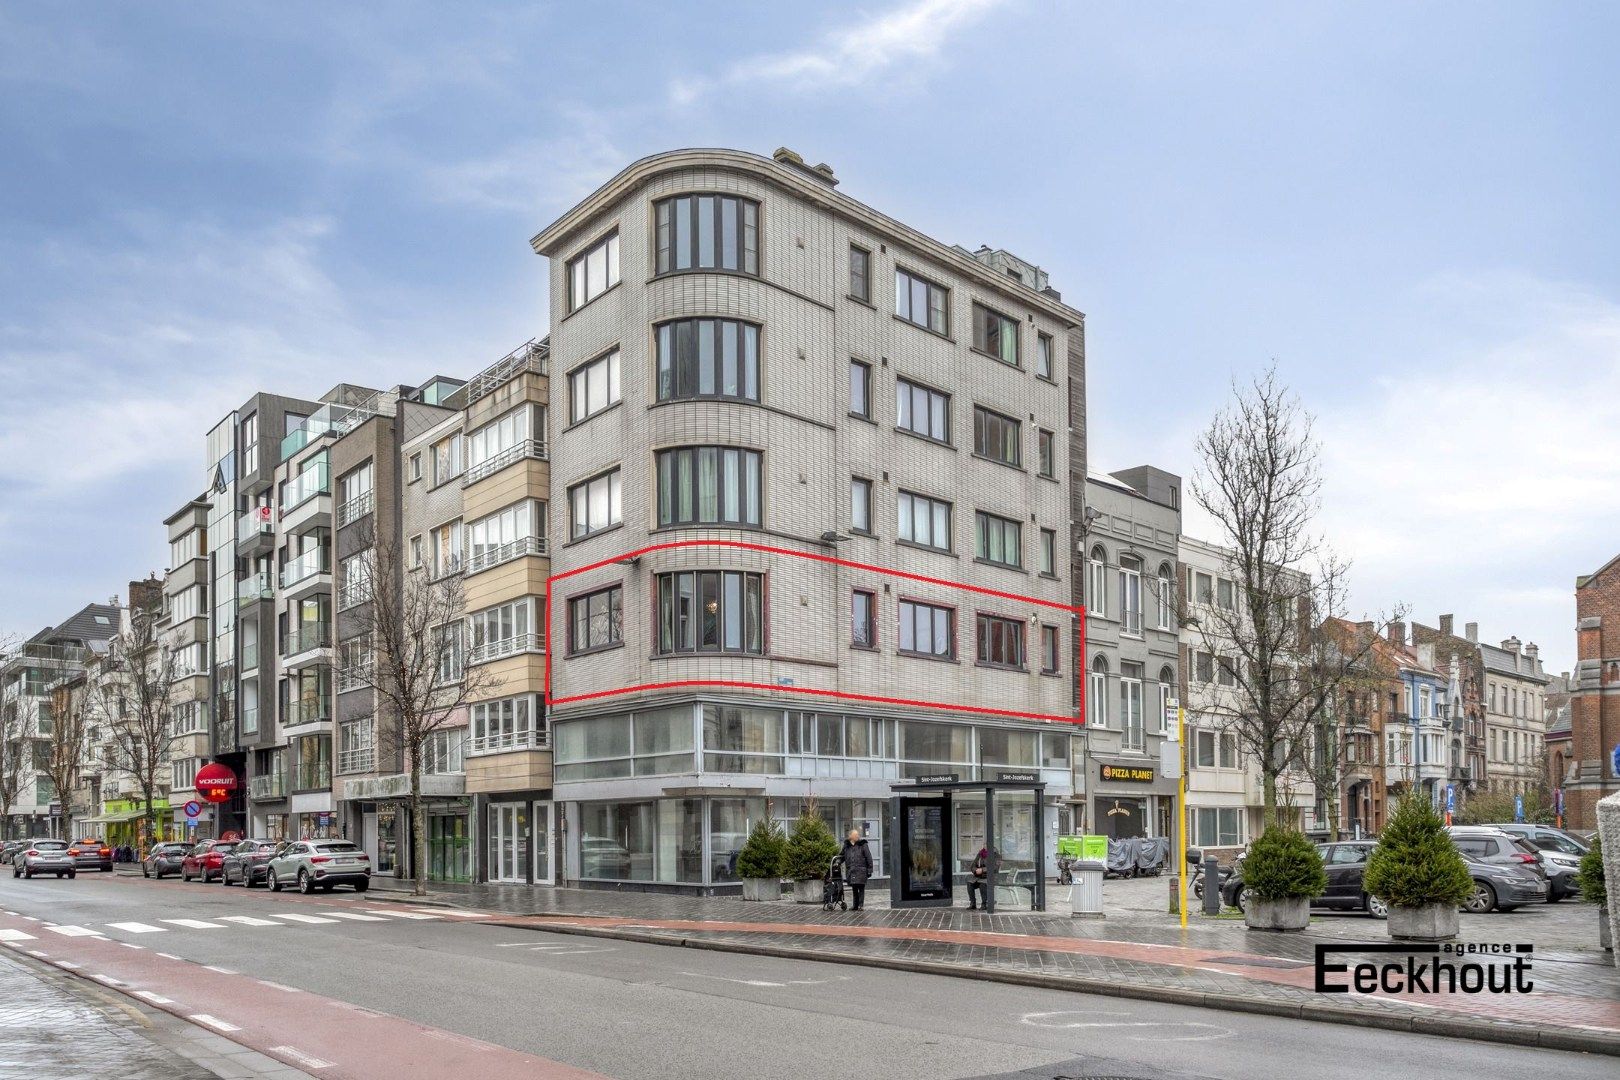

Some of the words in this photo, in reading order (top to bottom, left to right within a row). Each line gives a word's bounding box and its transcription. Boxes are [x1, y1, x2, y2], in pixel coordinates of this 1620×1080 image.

[1111, 768, 1130, 778] PIZZA
[1131, 769, 1153, 780] PLANET
[199, 777, 234, 785] VOORUIT
